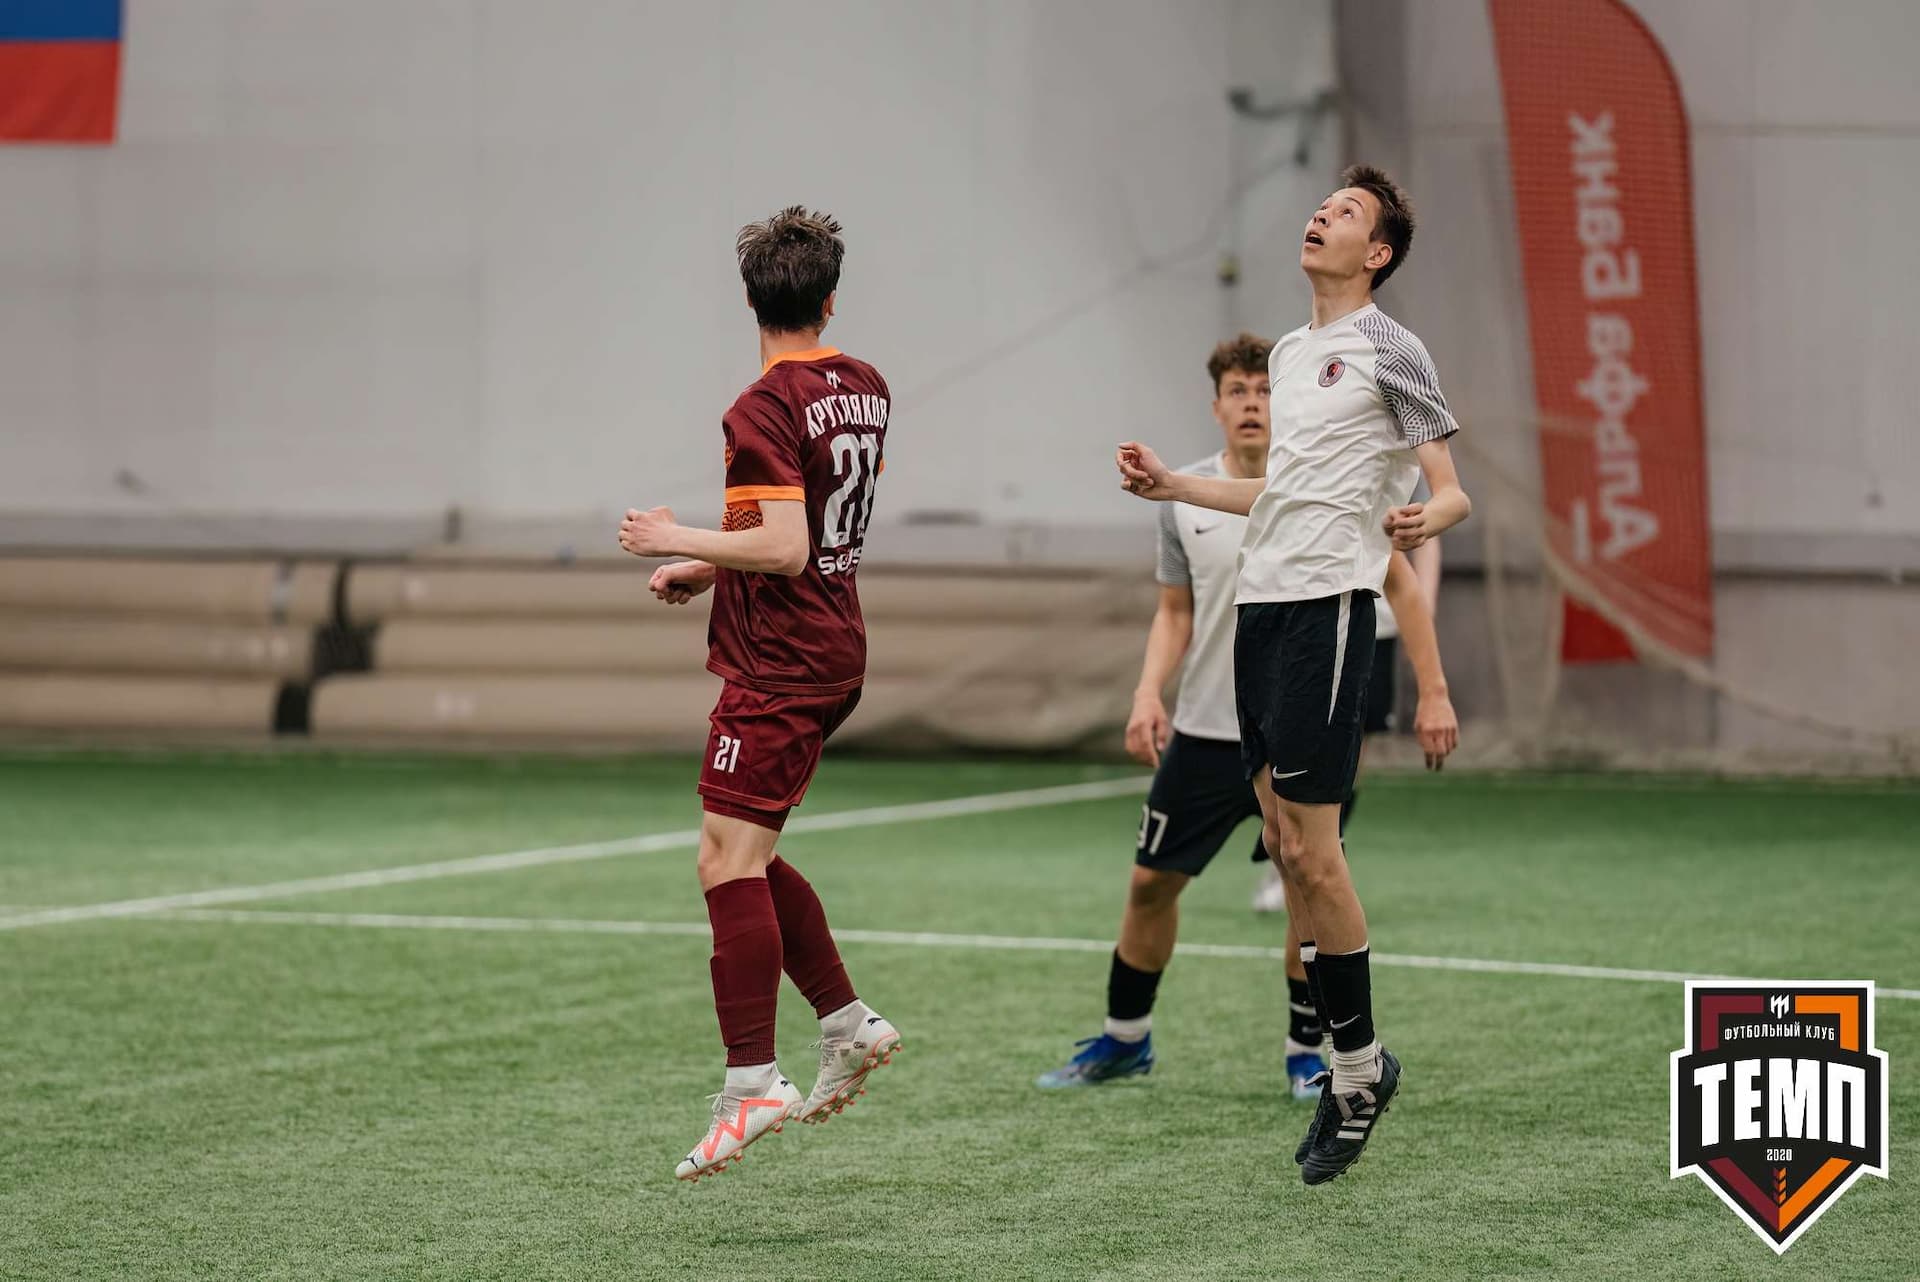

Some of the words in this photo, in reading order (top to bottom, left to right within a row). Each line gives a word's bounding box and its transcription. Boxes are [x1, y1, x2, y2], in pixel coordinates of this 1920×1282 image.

[805, 394, 887, 439] КРУГЛЯКОВ
[821, 433, 879, 548] 21
[713, 735, 741, 773] 21
